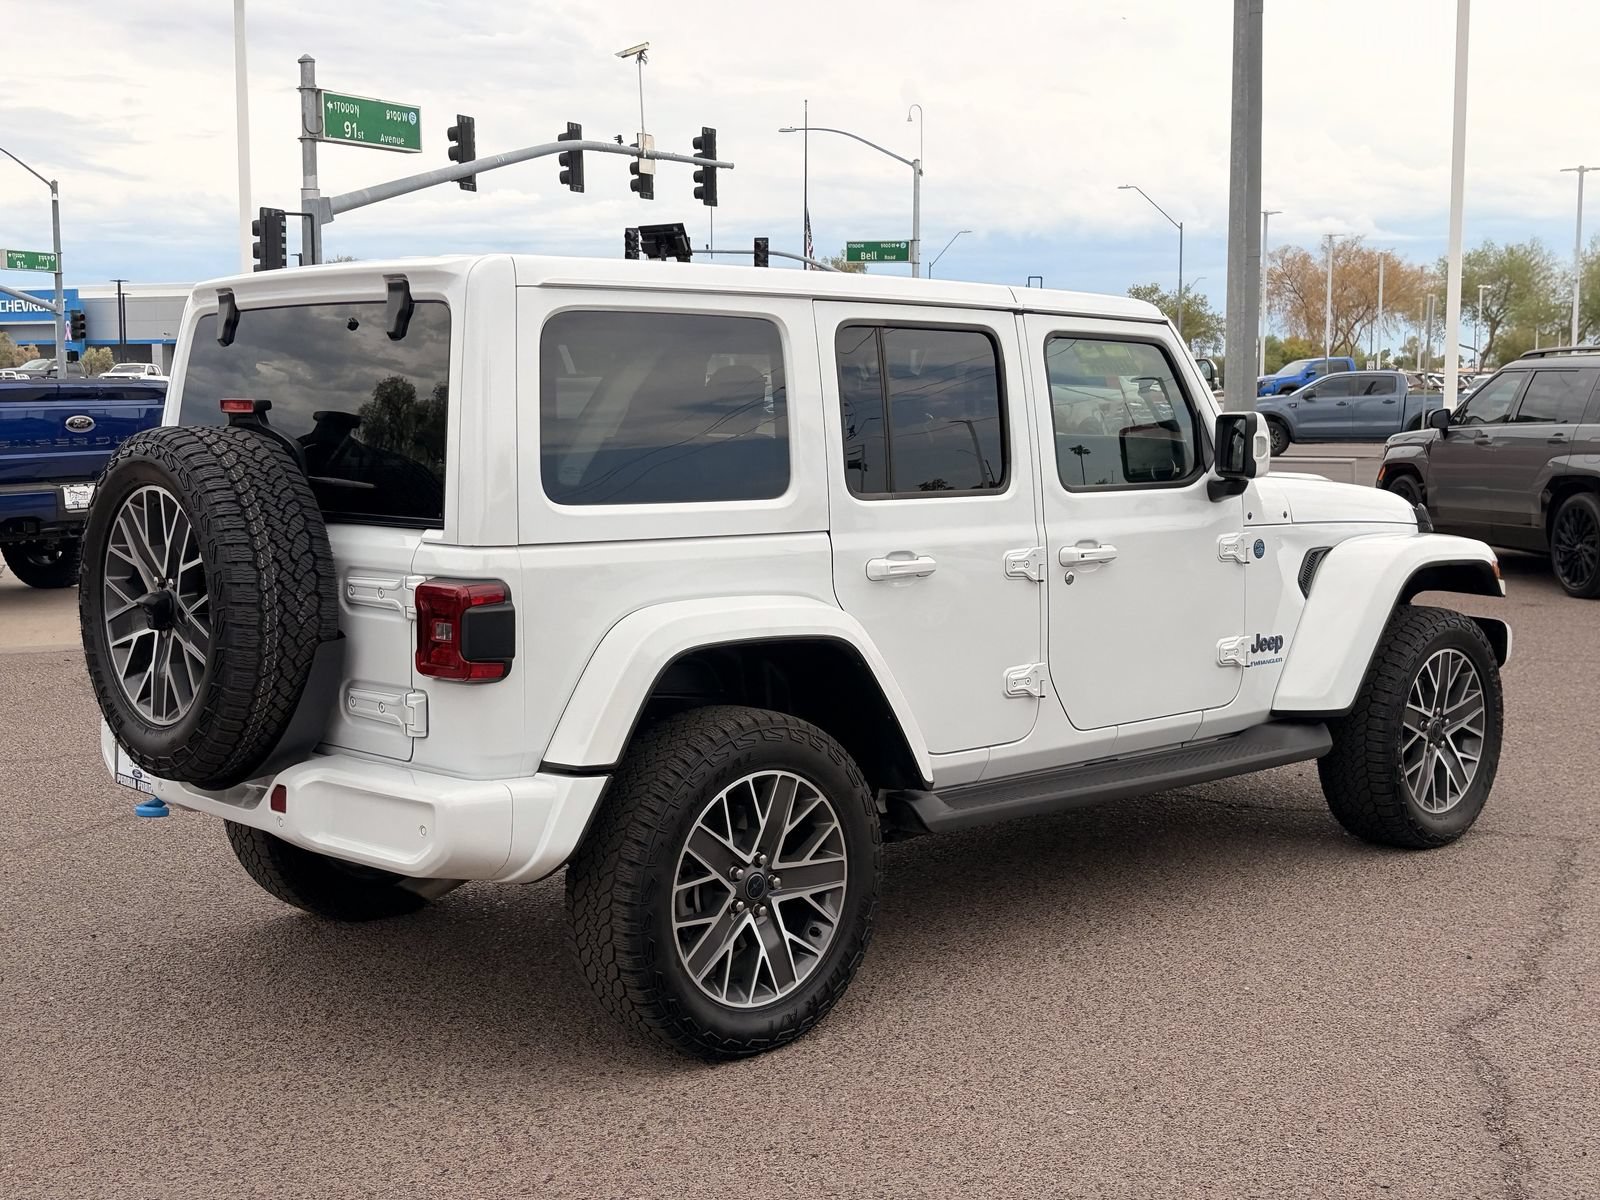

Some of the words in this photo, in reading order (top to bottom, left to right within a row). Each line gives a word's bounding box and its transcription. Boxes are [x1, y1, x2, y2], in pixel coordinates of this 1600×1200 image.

[333, 101, 360, 117] 17000N
[343, 121, 364, 139] 91st
[380, 133, 405, 145] Avenue
[860, 251, 878, 260] Bell
[1251, 633, 1284, 654] Jeep
